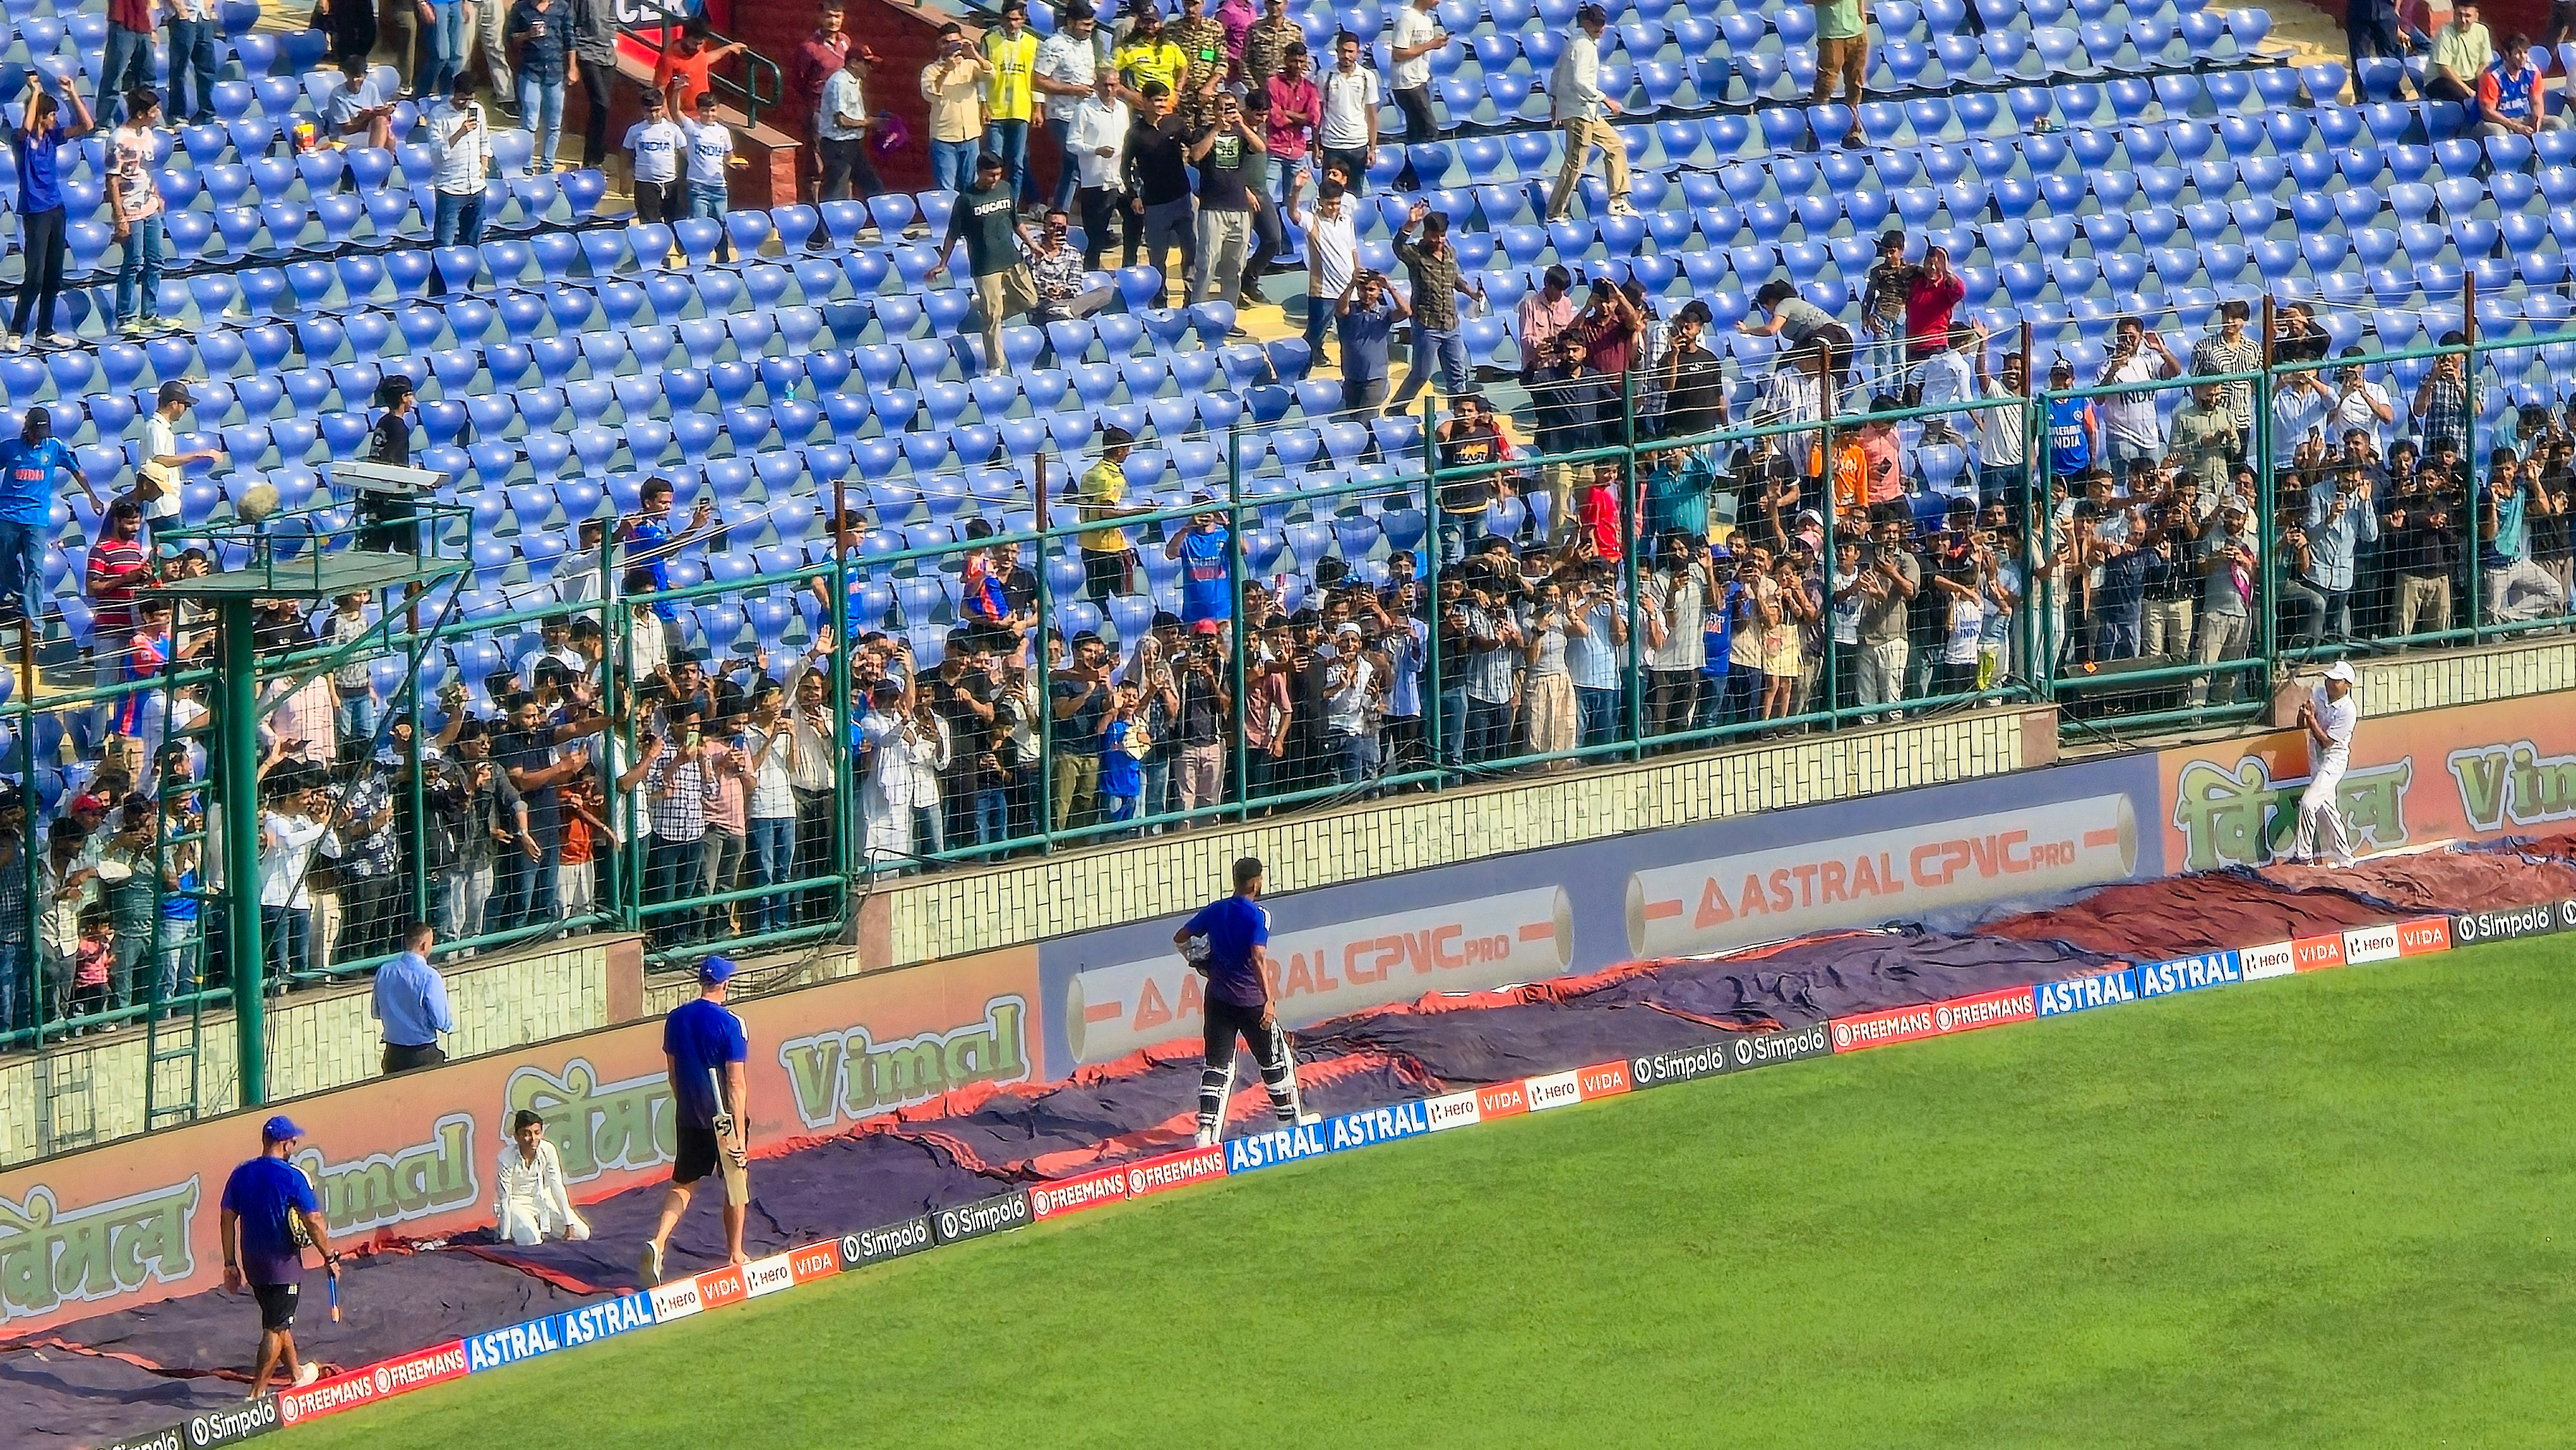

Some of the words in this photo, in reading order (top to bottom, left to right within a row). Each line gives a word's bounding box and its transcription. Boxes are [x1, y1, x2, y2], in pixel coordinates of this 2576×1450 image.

[974, 198, 1011, 216] DUCATI
[2050, 434, 2081, 449] INDIA
[1739, 853, 1904, 918] ASTRAL
[1910, 829, 2030, 887] CPVC
[2029, 840, 2076, 870] PRO
[2259, 952, 2289, 968] Hero
[2298, 944, 2339, 962] VIDA
[2363, 937, 2394, 950] Hero
[2403, 928, 2445, 947] VIDA
[1176, 949, 1339, 1020] ARAL
[1344, 923, 1464, 985] CPVC
[1464, 935, 1510, 966] PRO
[2144, 954, 2239, 997] ASTRAL
[1952, 995, 2033, 1026] FREEMANS
[2041, 973, 2135, 1015] ASTRAL
[1852, 1012, 1932, 1042] FREEMANS
[784, 1003, 1024, 1120] Vimal
[1445, 1101, 1474, 1118] Hero
[1482, 1090, 1523, 1111] VIDA
[1545, 1082, 1575, 1099] Hero
[1583, 1070, 1624, 1093] VIDA
[503, 1065, 676, 1175] विम
[1332, 1102, 1427, 1149] ASTRAL
[1231, 1124, 1325, 1171] ASTRAL
[299, 1122, 475, 1230] mal
[1144, 1151, 1224, 1187] FREEMANS
[1049, 1174, 1125, 1211] FREEMANS
[760, 1266, 788, 1285] Hero
[794, 1252, 833, 1276] VIDA
[668, 1290, 696, 1310] Hero
[703, 1276, 741, 1300] VIDA
[565, 1295, 653, 1346] ASTRAL
[471, 1320, 558, 1372] ASTRAL
[390, 1348, 465, 1388] FREEMANS
[297, 1376, 373, 1416] FREEMANS
